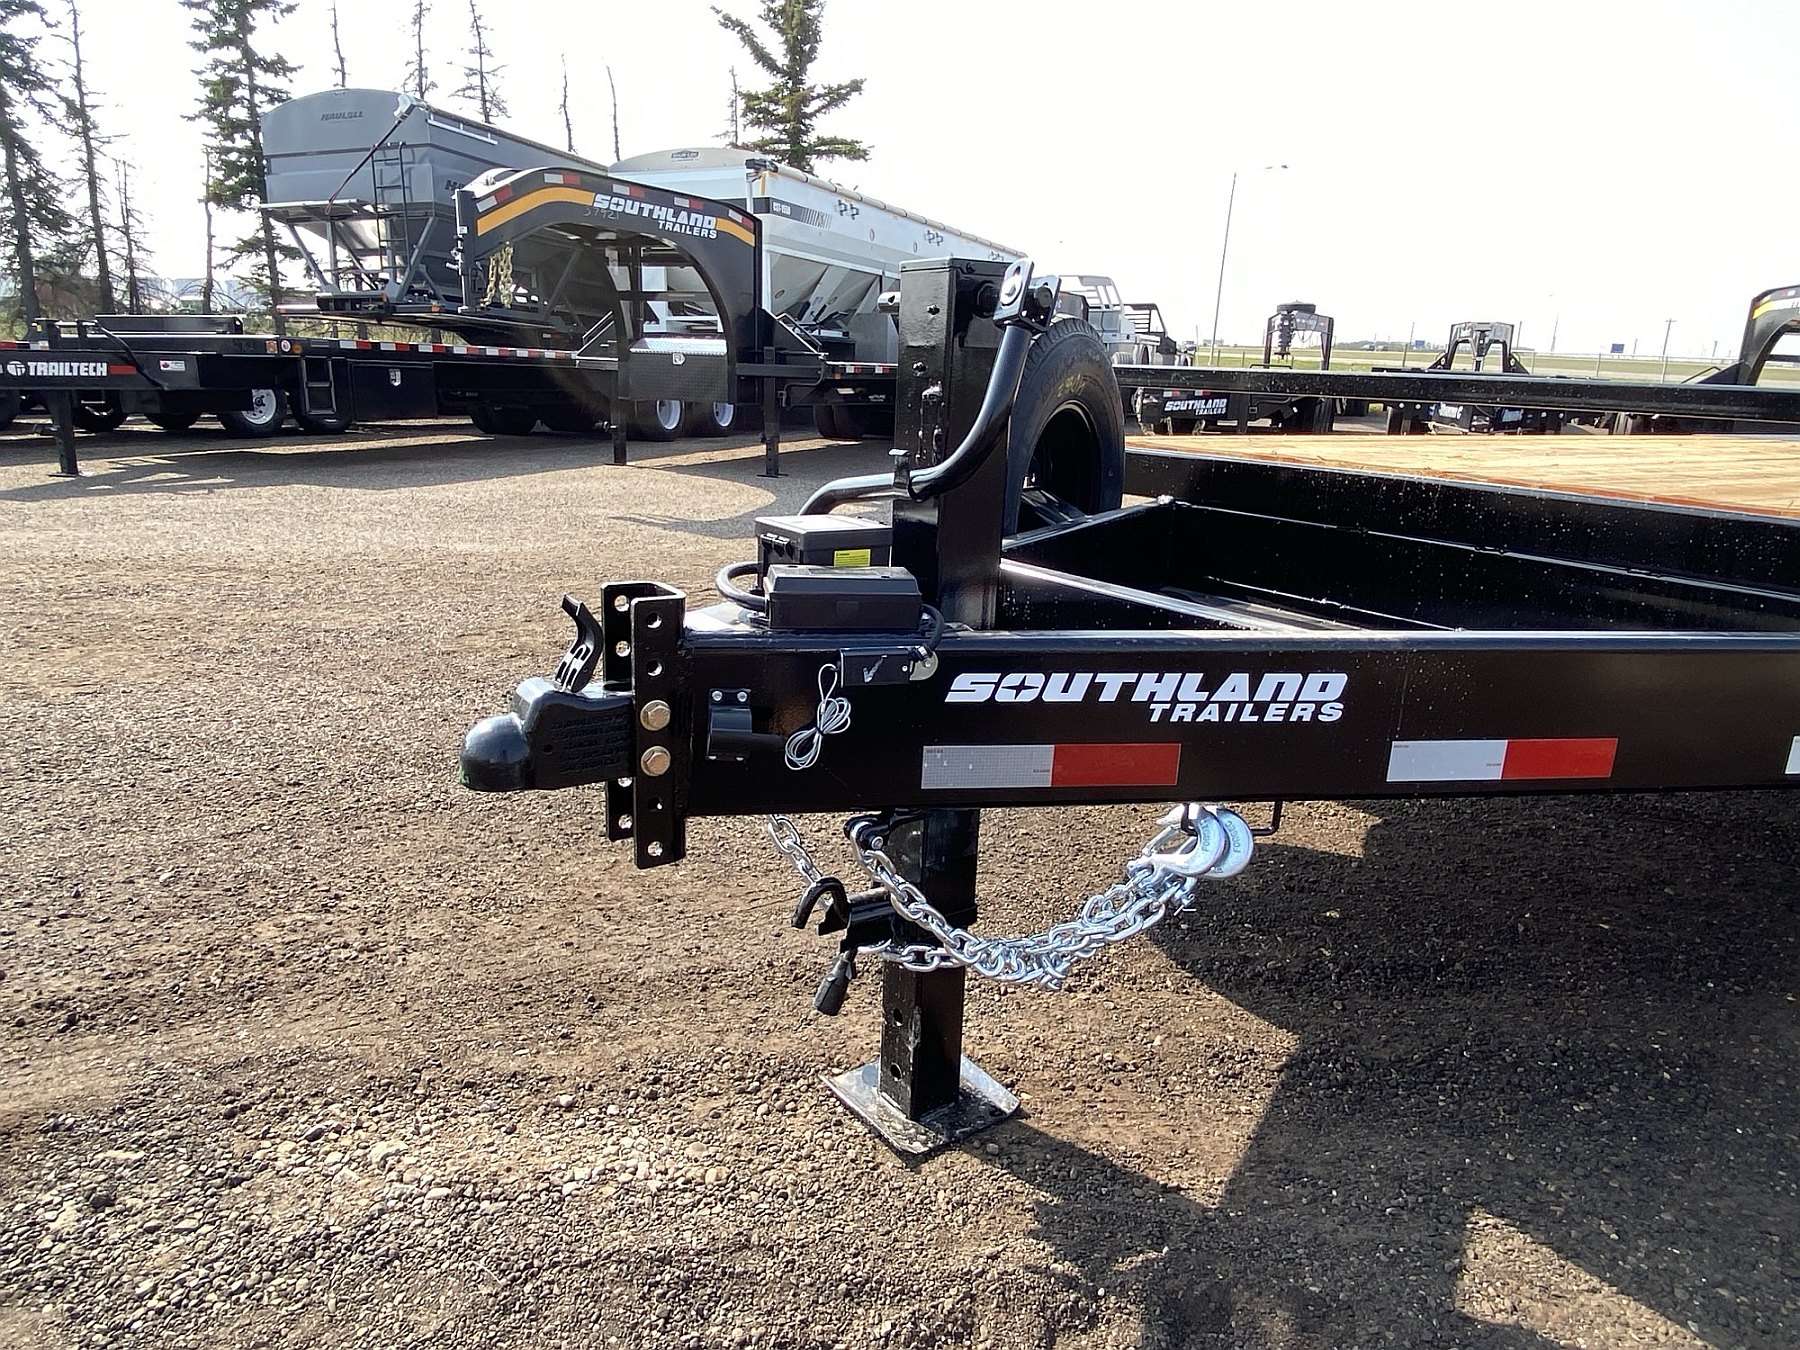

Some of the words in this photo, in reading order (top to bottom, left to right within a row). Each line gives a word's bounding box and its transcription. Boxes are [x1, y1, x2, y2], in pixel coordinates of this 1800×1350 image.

[593, 193, 718, 230] SOUTHLAND
[658, 220, 718, 239] TRAILERS
[27, 361, 108, 377] TRAILTECH
[1164, 398, 1228, 412] SOUTHLAND
[1195, 408, 1227, 416] TRAILERS
[944, 672, 1349, 703] SOUTHLAND
[1148, 702, 1344, 722] TRAILERS
